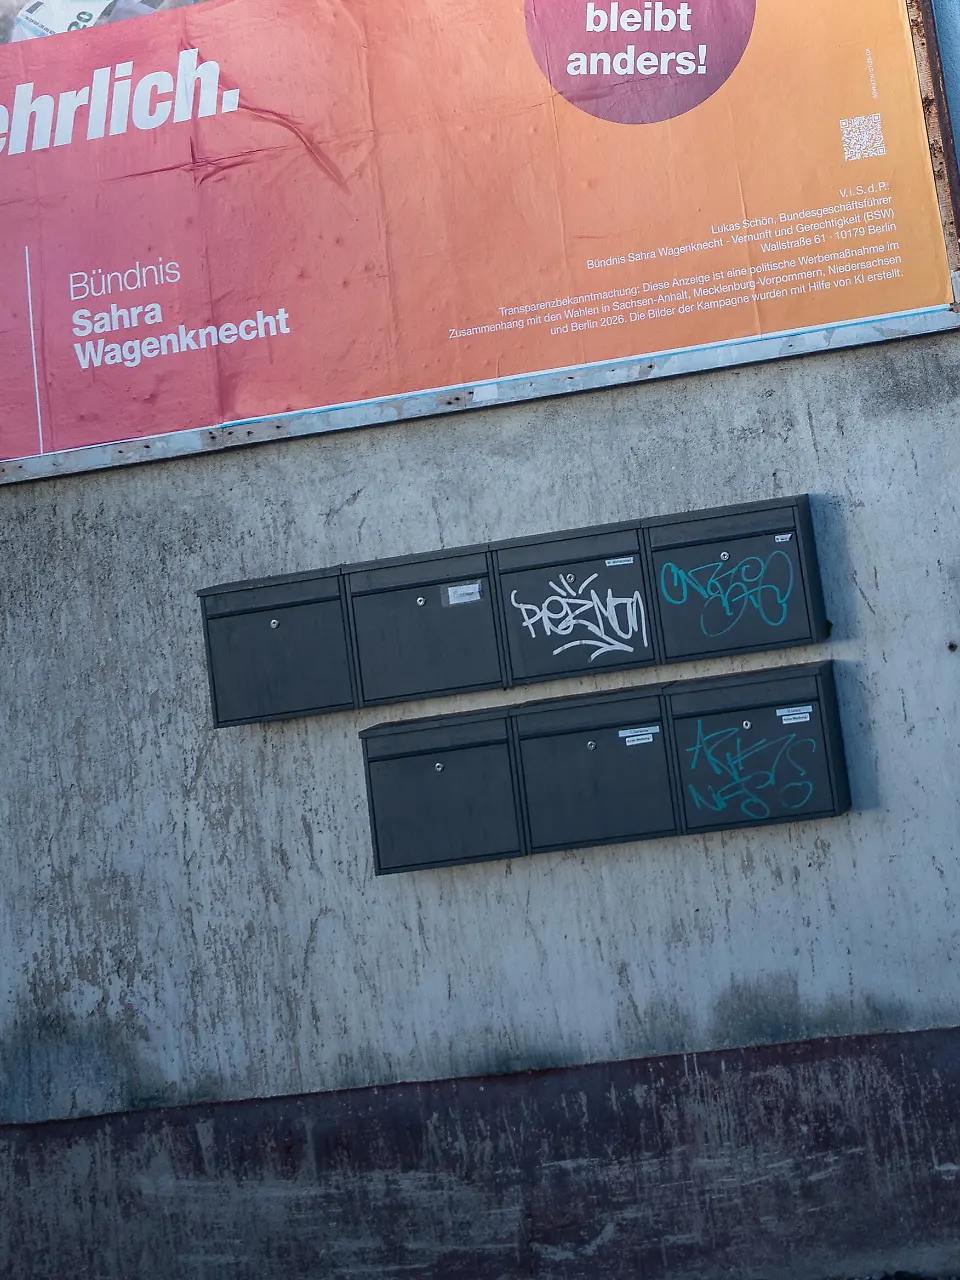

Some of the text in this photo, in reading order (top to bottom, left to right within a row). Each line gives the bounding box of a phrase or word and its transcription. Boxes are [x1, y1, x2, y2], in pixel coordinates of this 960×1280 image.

[586, 2, 692, 32] bleibt
[566, 45, 707, 76] anders!
[0, 47, 240, 156] hrlich.
[587, 254, 626, 269] Bündnis
[628, 247, 656, 263] Sahra
[658, 237, 724, 259] Wagenknecht
[731, 228, 772, 245] Vernunft
[775, 223, 794, 236] und
[796, 213, 862, 235] Gerechtigkeit
[863, 207, 895, 223] (BSW)
[711, 195, 892, 235] Lukas Schön, Bundesgeschäftsführer
[761, 236, 812, 254] Wallstraße
[814, 233, 827, 245] 61
[835, 226, 865, 241] 10179
[868, 220, 897, 235] Berlin
[68, 257, 181, 301] Bündnis
[449, 255, 902, 339] Zusammenhang mit den Wahlen in Sachsen-Anhalt, Mecklenburg-Vorpommern, Niedersachsen
[499, 241, 900, 317] Transparenzbekanntmachung: Diese Anzeige ist eine politische Werbemaßnahme im
[550, 268, 904, 336] und Berlin 2026. Die Bilder der Kampagne wurden mit Hilfe von KI erstellt.
[72, 298, 163, 337] Sahra
[74, 307, 291, 370] Wagenknecht
